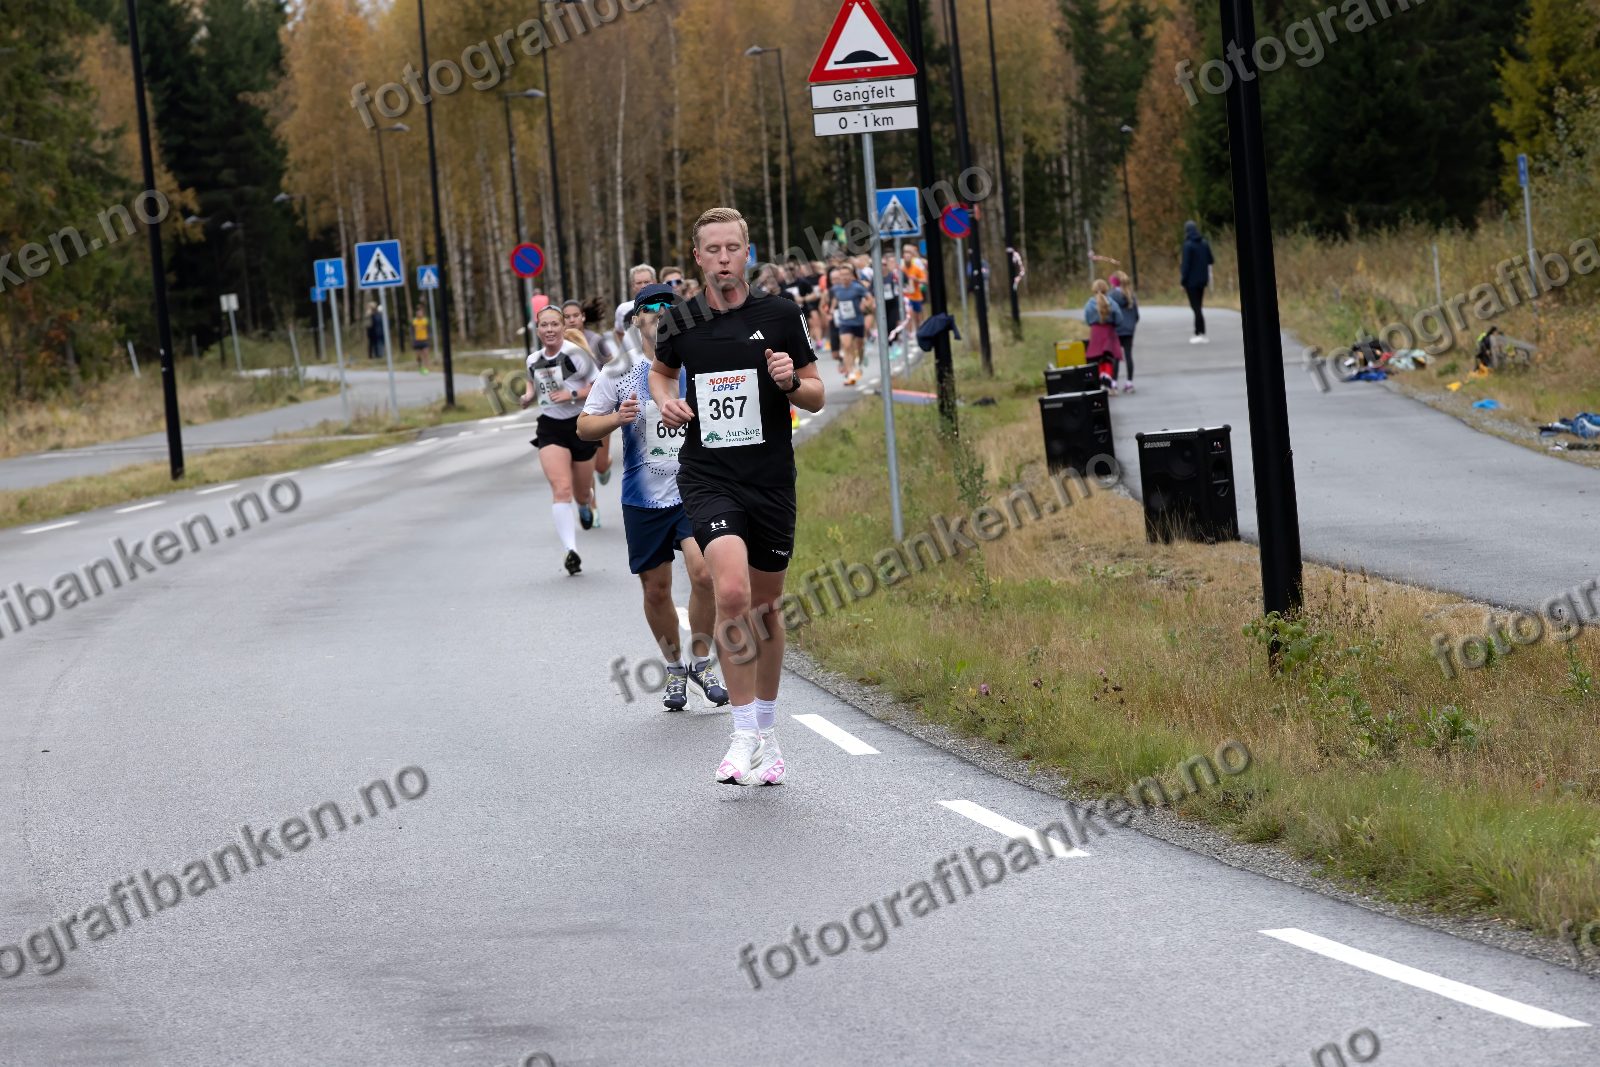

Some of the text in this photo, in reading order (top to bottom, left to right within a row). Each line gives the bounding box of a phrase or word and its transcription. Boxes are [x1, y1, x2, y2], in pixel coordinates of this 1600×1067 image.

[833, 85, 895, 103] Gangfelt
[873, 114, 894, 127] km
[708, 375, 747, 386] NORGES
[708, 396, 748, 421] 367
